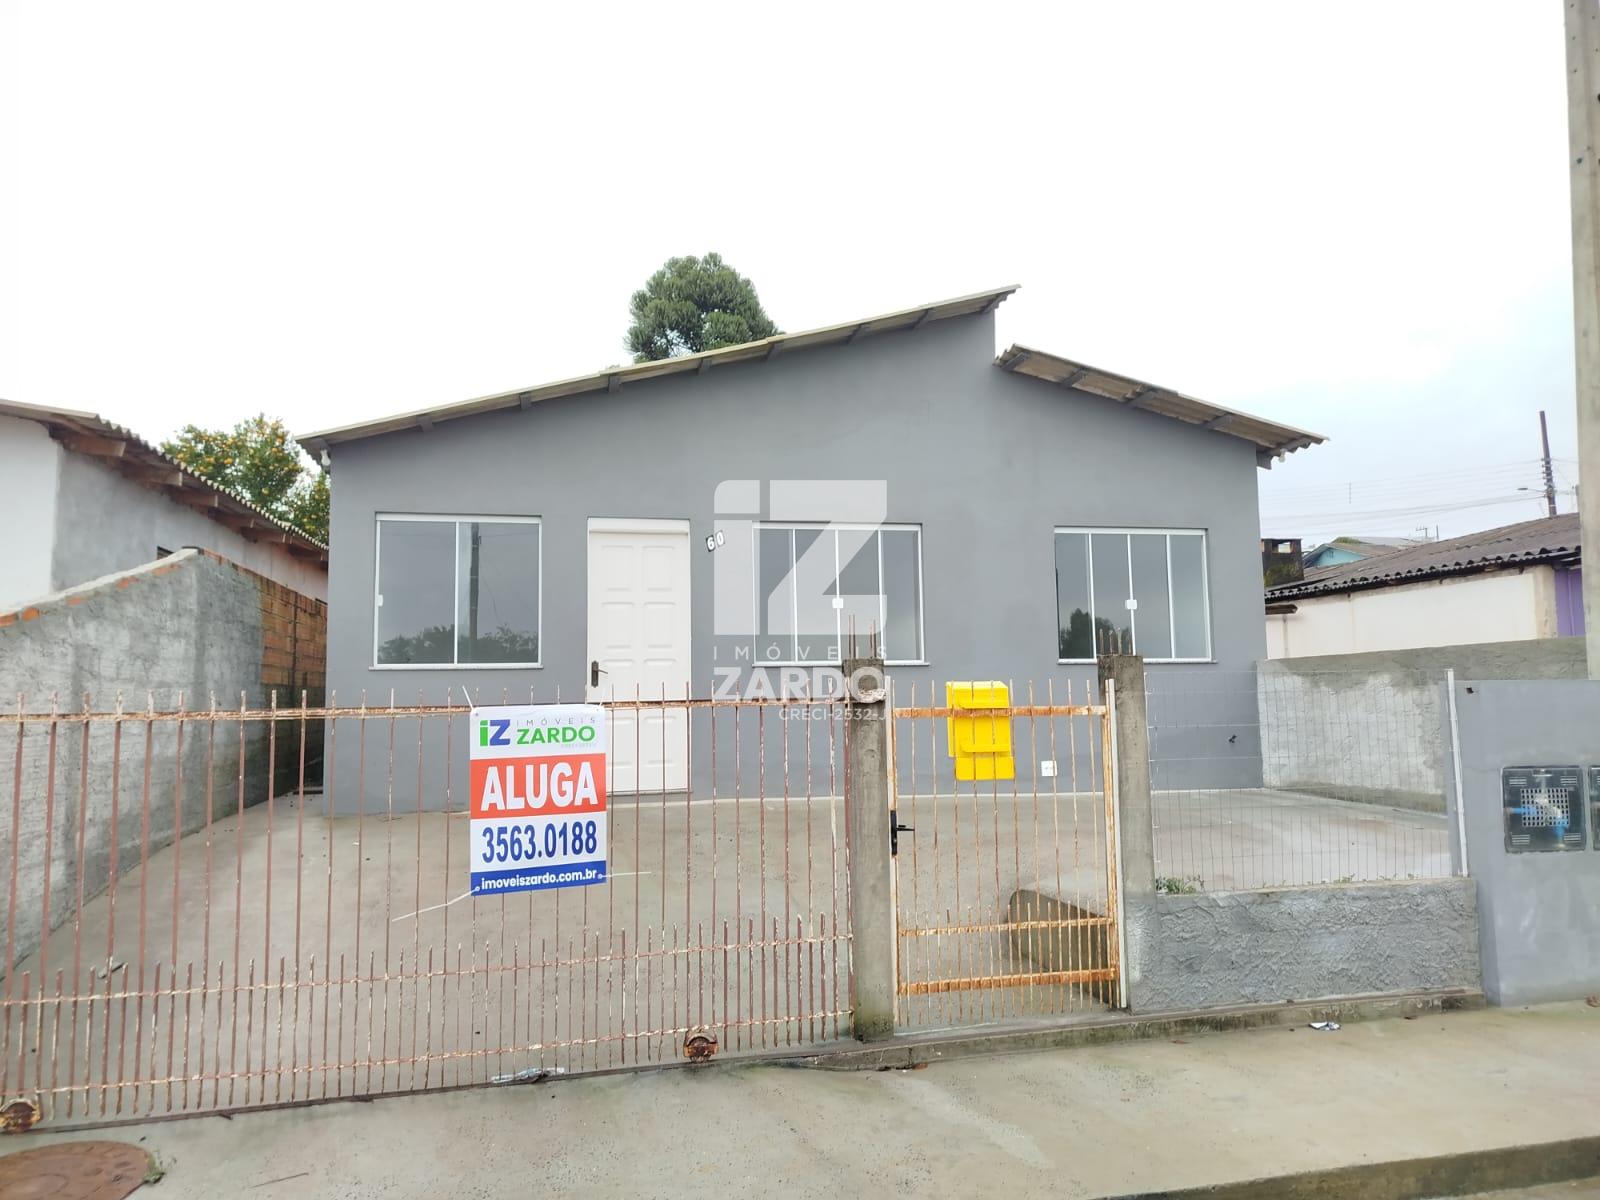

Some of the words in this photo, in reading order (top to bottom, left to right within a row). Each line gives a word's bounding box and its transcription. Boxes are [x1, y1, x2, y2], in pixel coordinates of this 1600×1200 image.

[706, 531, 724, 551] 60
[516, 717, 596, 726] IMÓVEIS
[516, 725, 595, 744] ZARDO
[480, 762, 598, 811] ALUGA
[482, 820, 597, 863] 3563.0188
[481, 869, 597, 890] imoveiszardo.com.br
